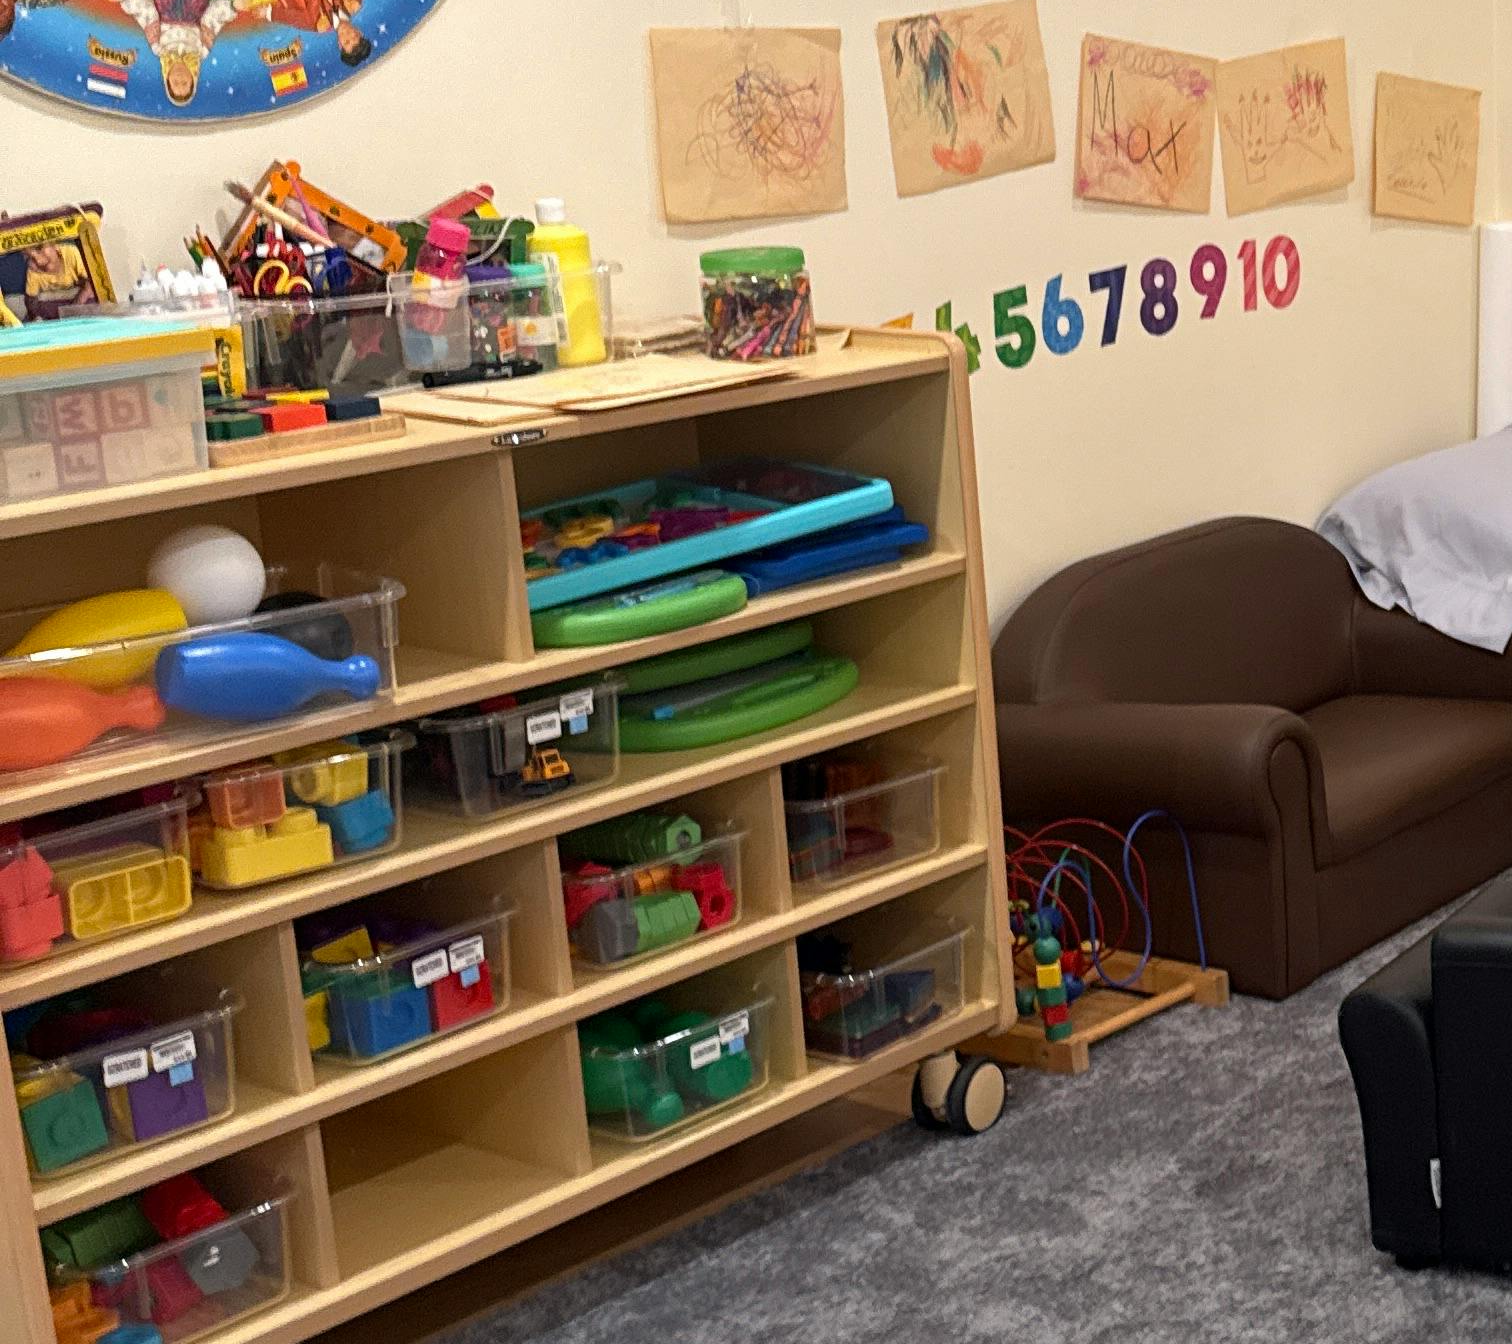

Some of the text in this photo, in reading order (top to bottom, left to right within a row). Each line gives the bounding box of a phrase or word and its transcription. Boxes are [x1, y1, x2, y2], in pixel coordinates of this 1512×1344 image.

[94, 47, 129, 65] Russia
[269, 47, 298, 65] Spain
[1091, 69, 1187, 176] Max
[993, 284, 1036, 370] 5
[1041, 273, 1085, 356] 6
[1088, 264, 1128, 348] 7
[1140, 257, 1179, 337] 8
[1189, 242, 1228, 320] 9
[1237, 234, 1301, 313] 10
